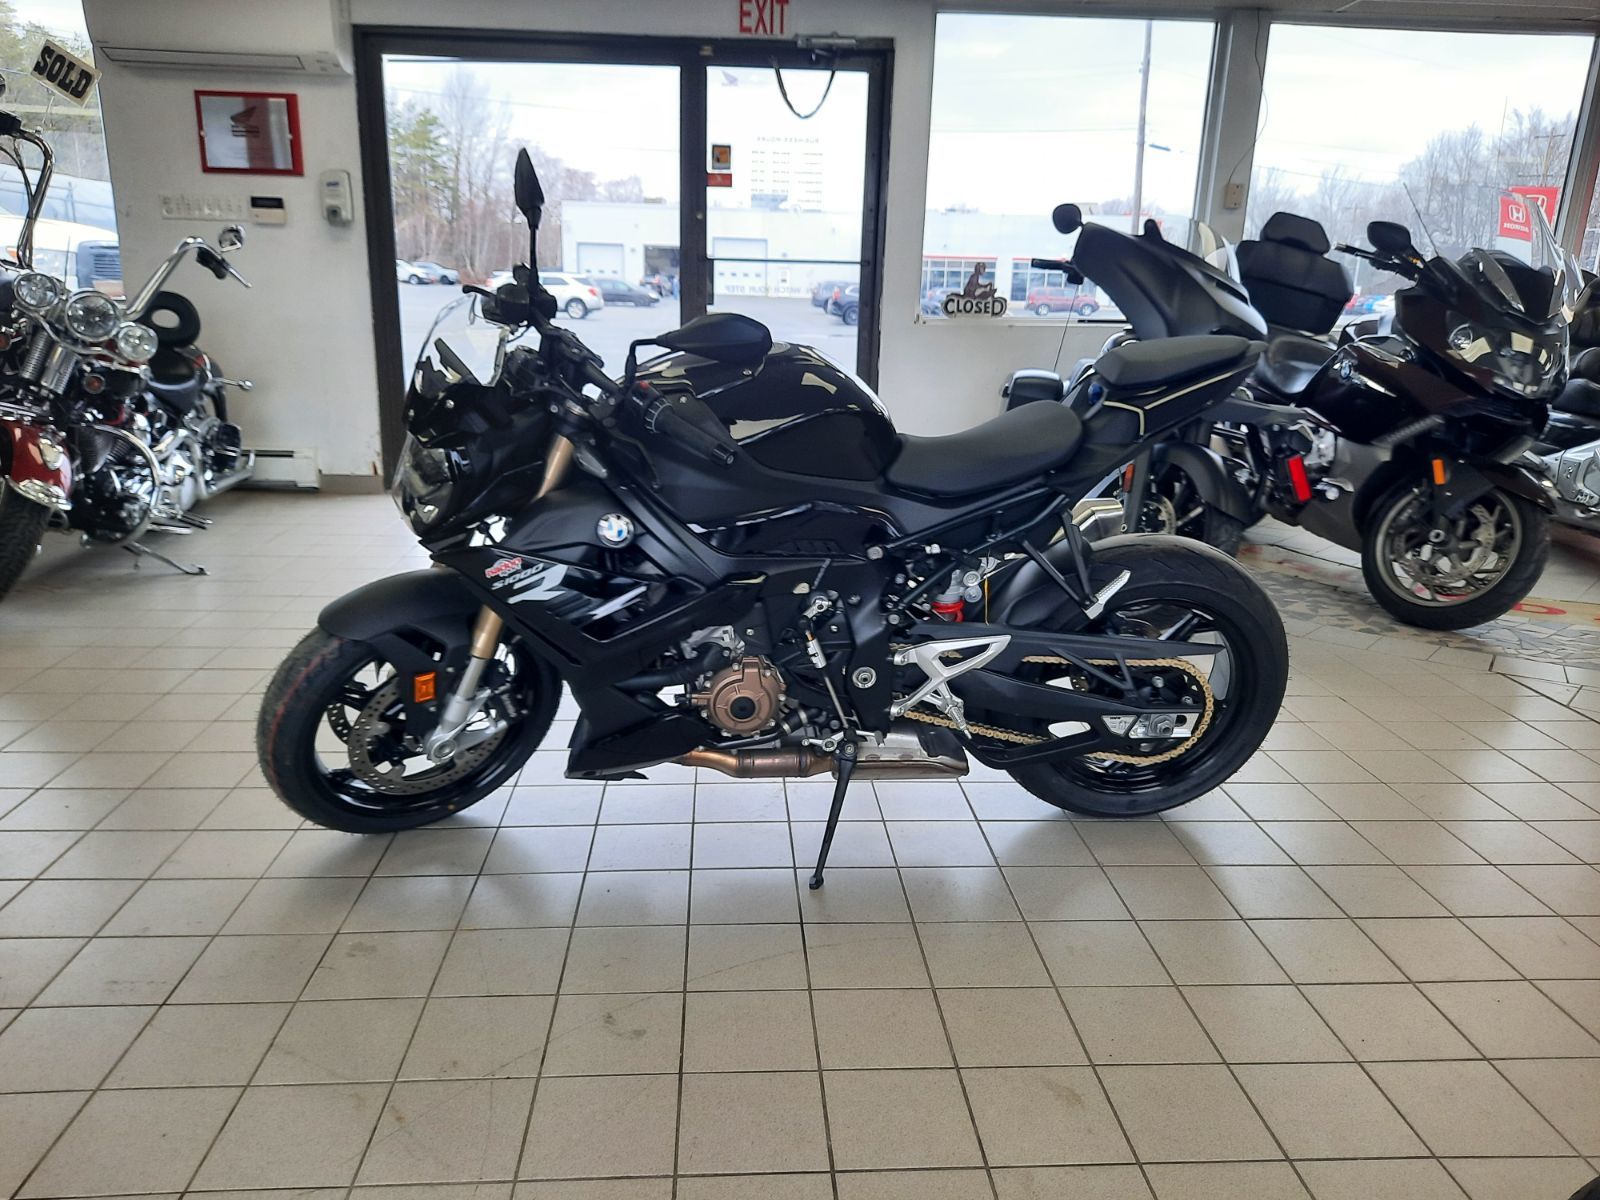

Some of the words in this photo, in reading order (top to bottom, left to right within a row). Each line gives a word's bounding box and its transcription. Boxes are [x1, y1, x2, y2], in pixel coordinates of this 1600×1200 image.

[739, 0, 790, 35] EXIT
[33, 45, 93, 98] SOLD
[1503, 222, 1529, 233] HONDA
[945, 298, 1003, 316] CLOSED
[491, 563, 544, 590] S1000
